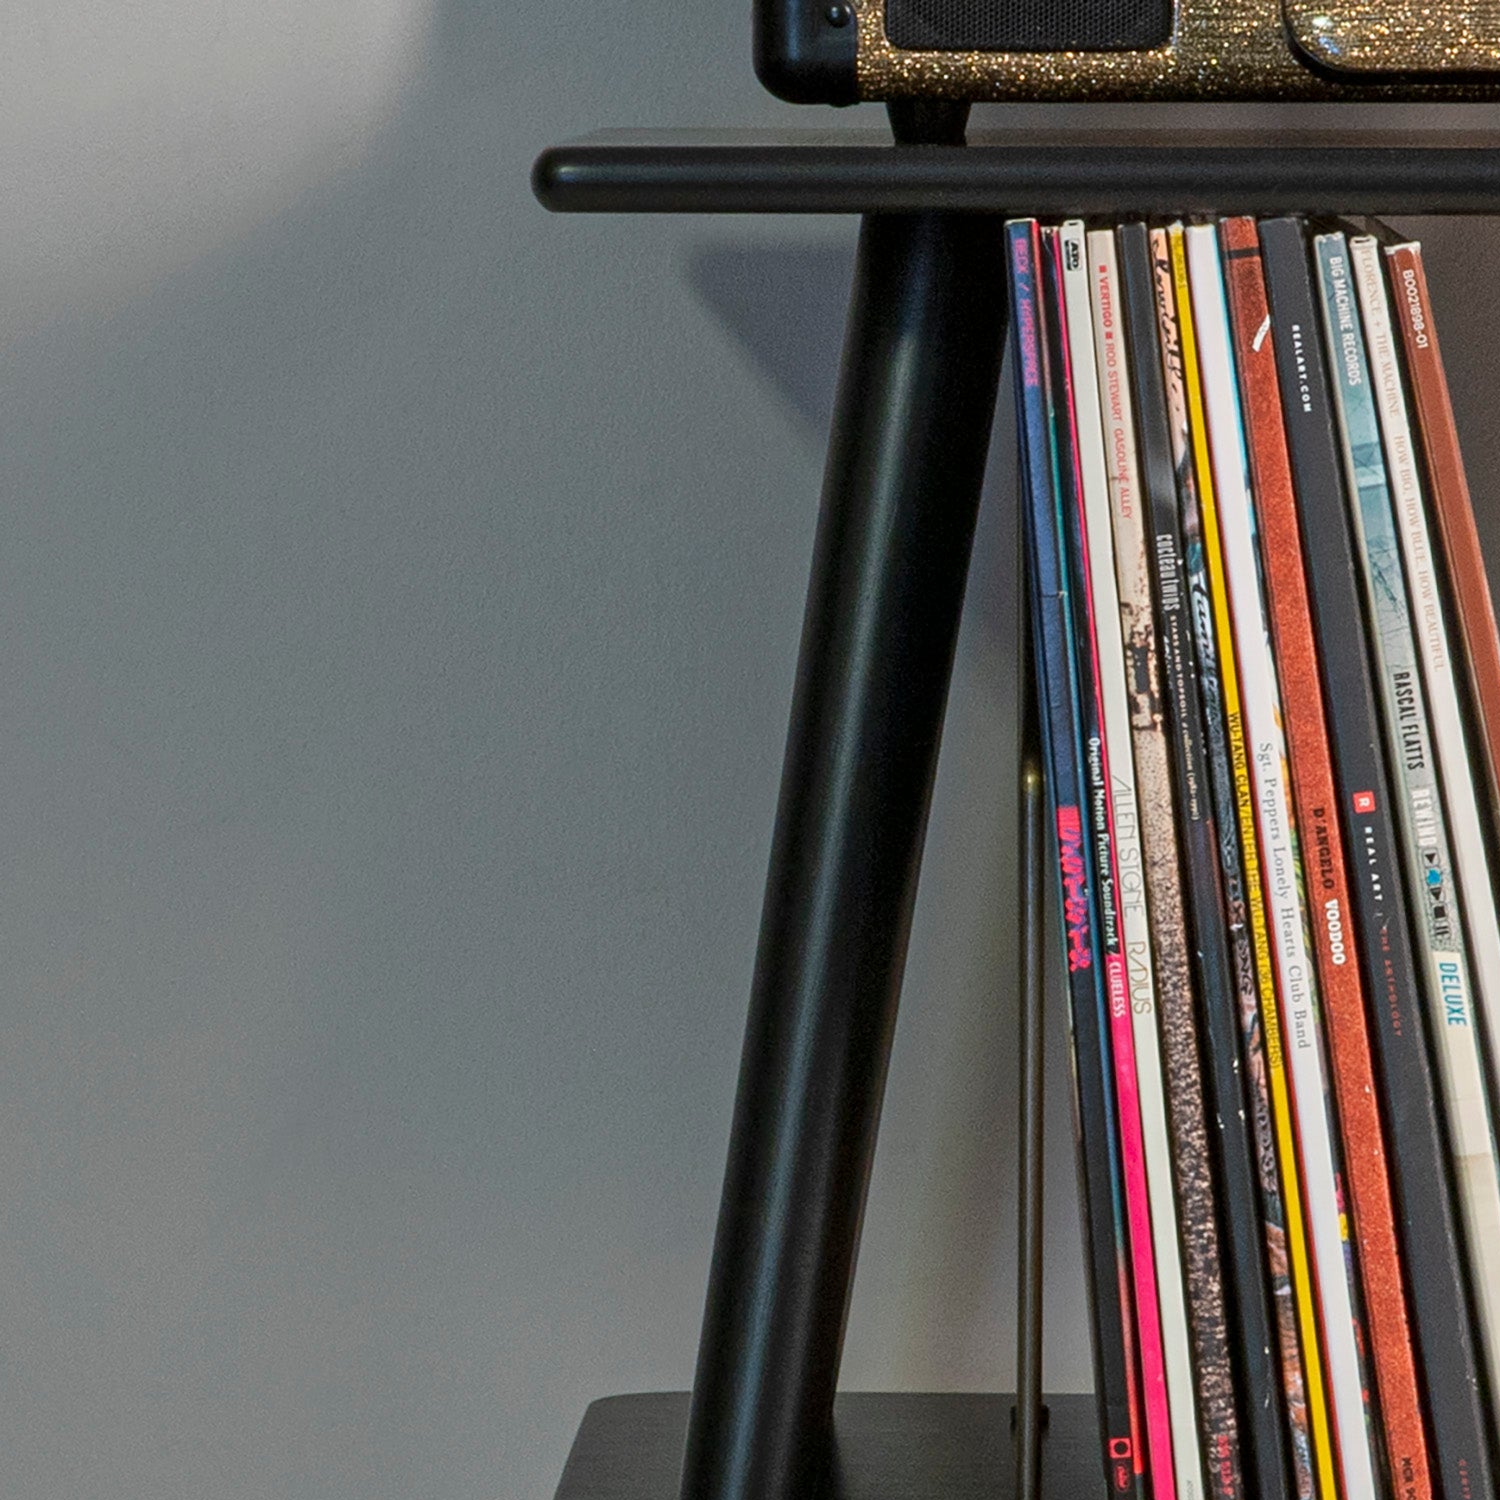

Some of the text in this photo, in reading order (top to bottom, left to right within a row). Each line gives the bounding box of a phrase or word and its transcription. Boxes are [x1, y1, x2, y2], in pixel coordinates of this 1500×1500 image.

[1014, 238, 1028, 273] BECK
[1361, 249, 1381, 316] FLORENCE
[1329, 256, 1360, 386] BIG MACHINE RECORDS
[1403, 269, 1426, 349] B0021898-01
[1293, 324, 1310, 412] REALART.COM
[1375, 333, 1388, 360] THE
[1100, 277, 1131, 520] VERTIGO ROD STEWART GASOLINE ALLEY
[1382, 362, 1399, 417] MACHINE
[1394, 436, 1407, 466] HOW
[1405, 498, 1419, 529] HOW
[1418, 571, 1432, 602] HOW
[1156, 534, 1178, 578] cocteau
[1170, 616, 1178, 646] STARS
[1177, 675, 1186, 717] TOPSOIL
[1183, 729, 1194, 770] collection
[1424, 605, 1444, 672] BEAUTIFUL
[1088, 738, 1102, 786] Original
[1230, 712, 1245, 770] WU-TANG
[1394, 672, 1436, 847] RASCAL FLATTS REWIND
[1093, 789, 1106, 830] Motion
[1097, 833, 1111, 876] Picture
[1246, 866, 1260, 892] THE
[1314, 807, 1345, 965] D'ANGELO VOODOO
[1101, 879, 1117, 945] Soundtrack
[1113, 774, 1136, 841] ALLEN
[1128, 942, 1151, 1015] RADIUS
[1257, 743, 1309, 1049] Sgt. Peppers Lonely Hearts Club Band
[1251, 897, 1268, 961] WU-TANG
[1364, 826, 1375, 865] REAL
[1371, 873, 1381, 902] ART
[1385, 959, 1400, 1037] ANTHOLOGY
[1110, 962, 1124, 1018] CLUELESS
[1258, 964, 1270, 984] (36
[1439, 961, 1466, 1028] DELUXE
[1262, 987, 1280, 1069] CHAMBERS)
